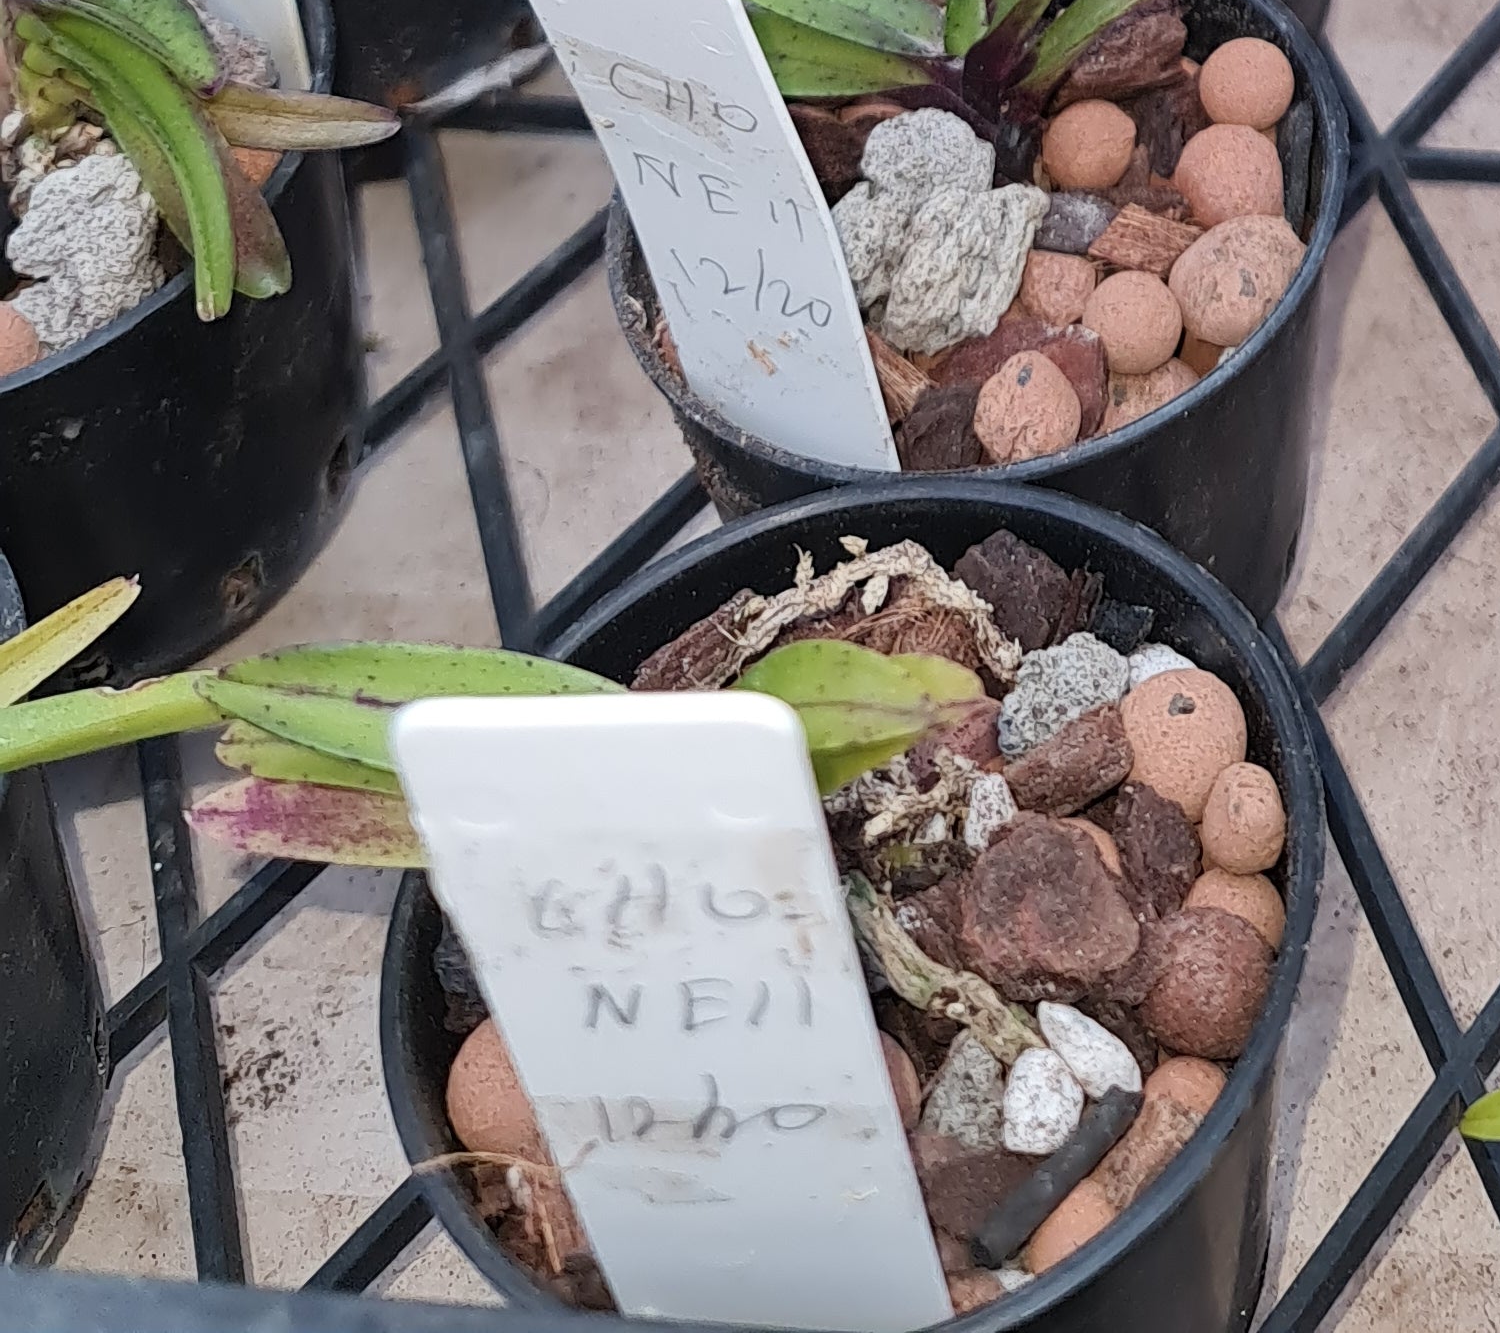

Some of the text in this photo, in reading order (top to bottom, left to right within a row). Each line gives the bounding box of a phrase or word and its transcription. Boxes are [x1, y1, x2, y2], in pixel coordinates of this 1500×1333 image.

[608, 62, 758, 133] CHO
[668, 247, 833, 327] 12/20
[526, 862, 771, 939] CHO
